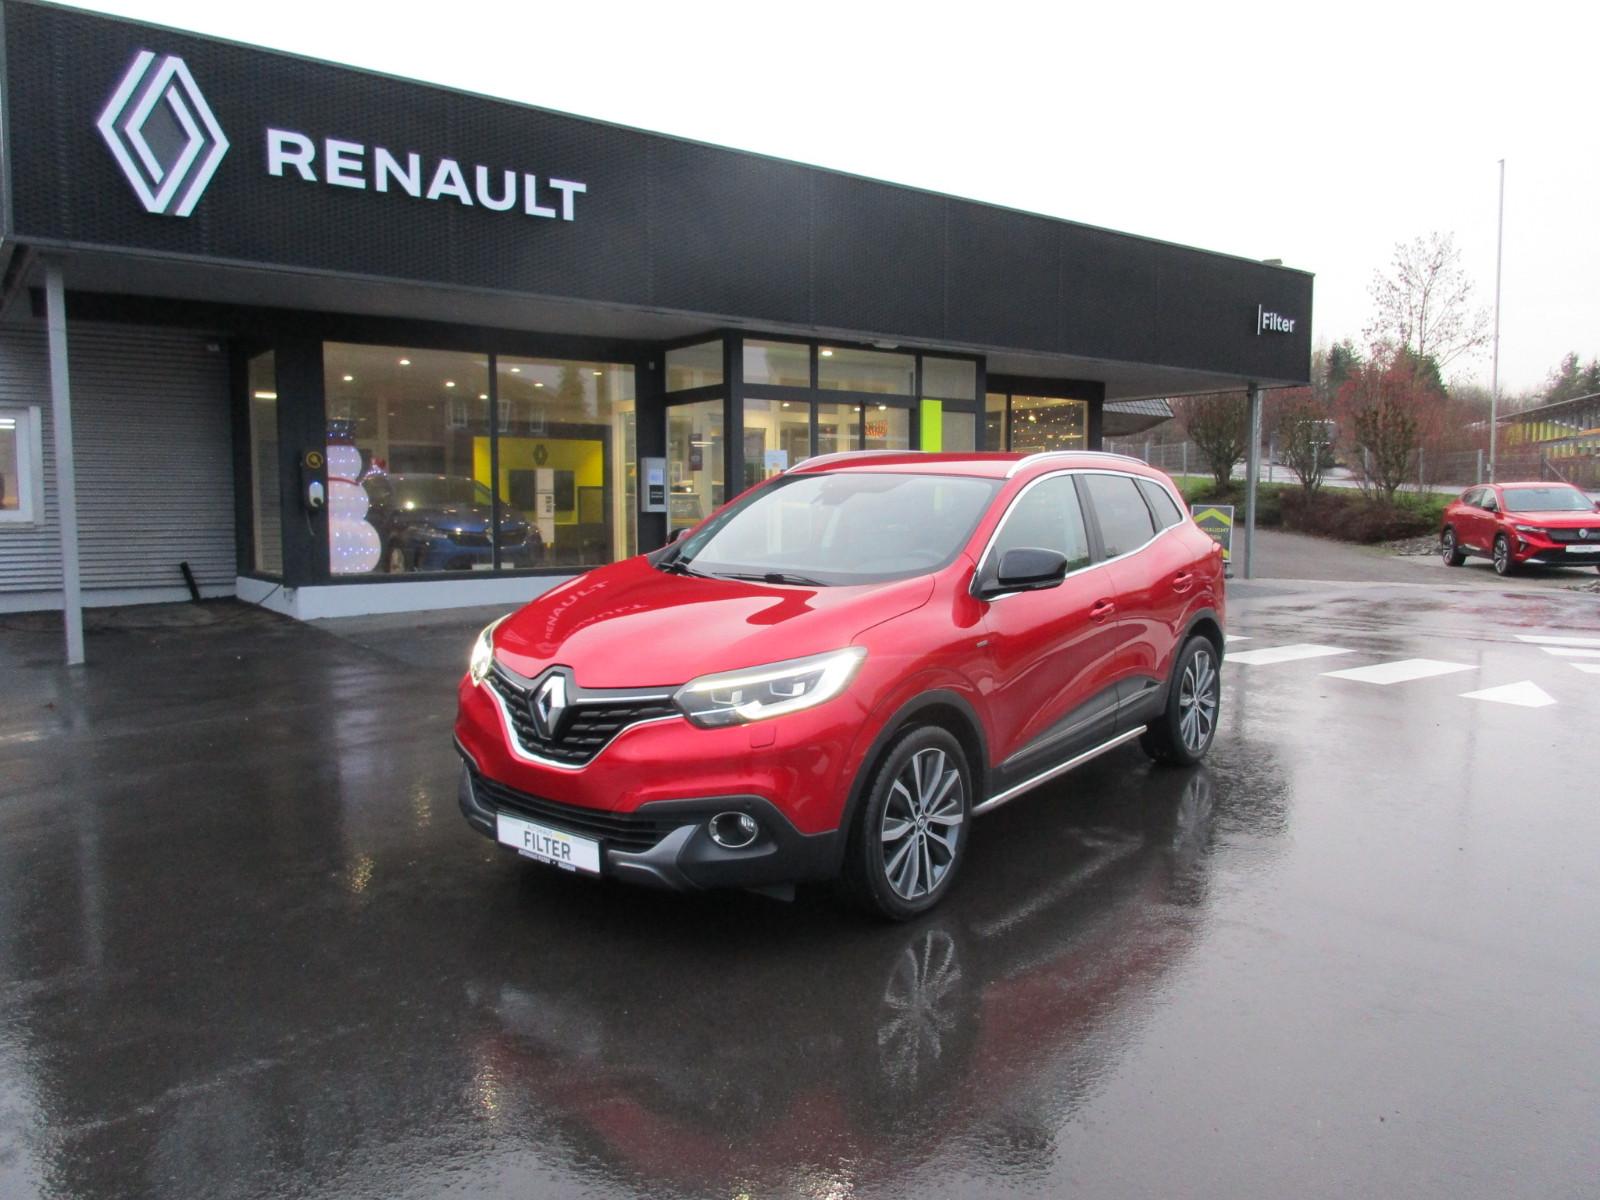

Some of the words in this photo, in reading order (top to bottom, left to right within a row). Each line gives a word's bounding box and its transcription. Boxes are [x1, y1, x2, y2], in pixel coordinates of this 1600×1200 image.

[267, 128, 587, 221] RENAULT
[1262, 312, 1295, 333] Filter
[523, 830, 571, 860] FILTER
